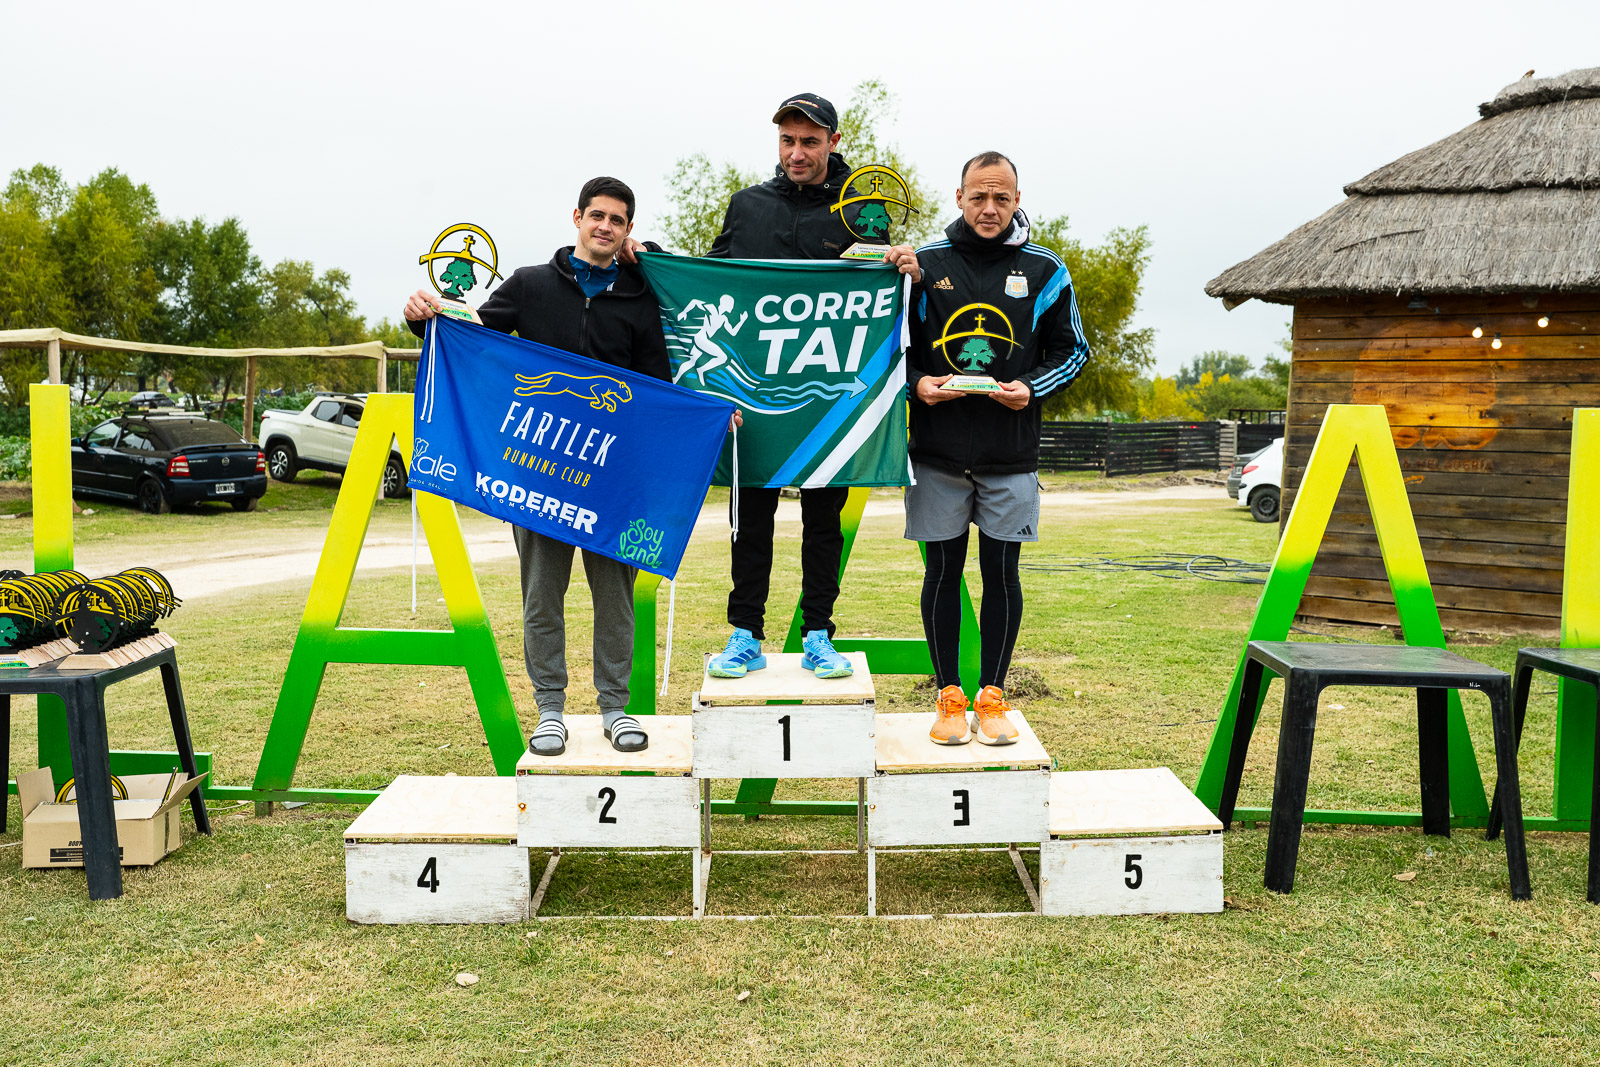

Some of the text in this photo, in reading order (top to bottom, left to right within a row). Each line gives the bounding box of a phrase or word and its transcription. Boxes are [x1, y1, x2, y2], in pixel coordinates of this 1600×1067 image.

[755, 286, 896, 323] CORRE
[758, 325, 868, 375] TAI
[500, 400, 617, 467] FARTLEK
[502, 446, 591, 487] RUNNING CLUB
[475, 471, 598, 534] KODERER
[475, 488, 573, 527] AUTOMOTORES
[616, 531, 663, 568] land
[627, 518, 664, 550] Soy
[778, 715, 791, 762] 1
[597, 787, 617, 824] 2
[952, 789, 969, 826] 3
[416, 856, 439, 893] 4
[1124, 853, 1143, 890] 5
